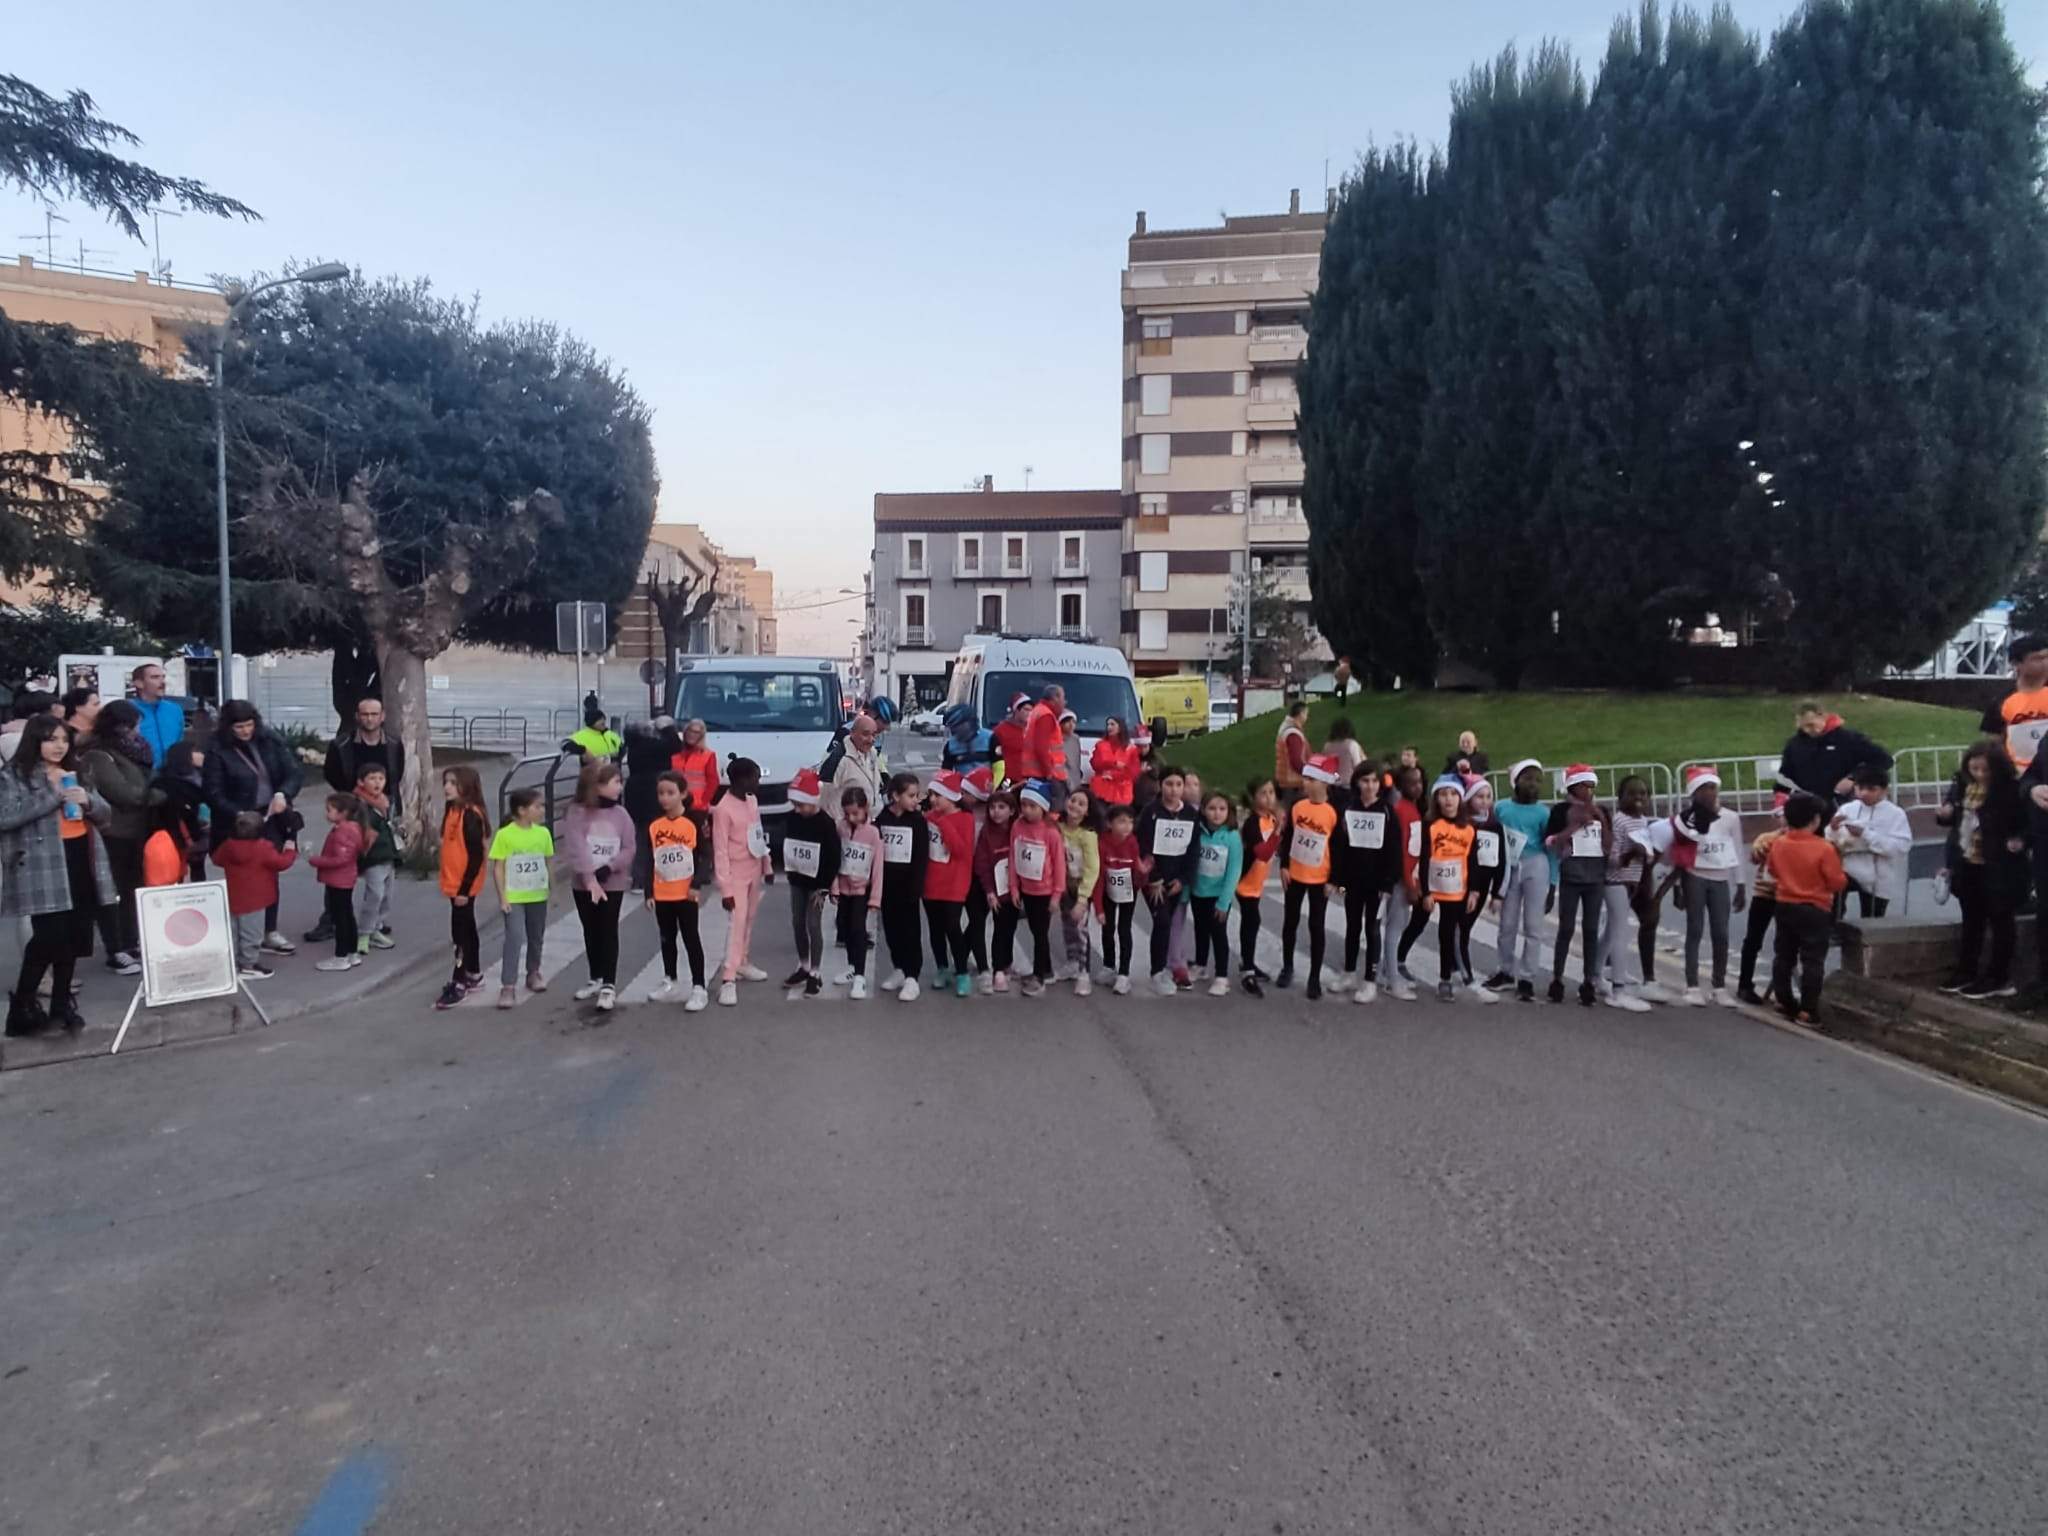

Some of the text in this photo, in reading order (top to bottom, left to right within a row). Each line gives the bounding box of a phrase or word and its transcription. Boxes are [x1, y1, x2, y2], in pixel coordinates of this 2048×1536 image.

[1353, 819, 1375, 831] 226
[1164, 827, 1185, 839] 262
[1297, 836, 1318, 849] 247
[660, 851, 684, 865] 265
[792, 846, 812, 860] 158
[844, 847, 866, 861] 284
[1199, 847, 1219, 861] 282
[515, 861, 539, 873] 323
